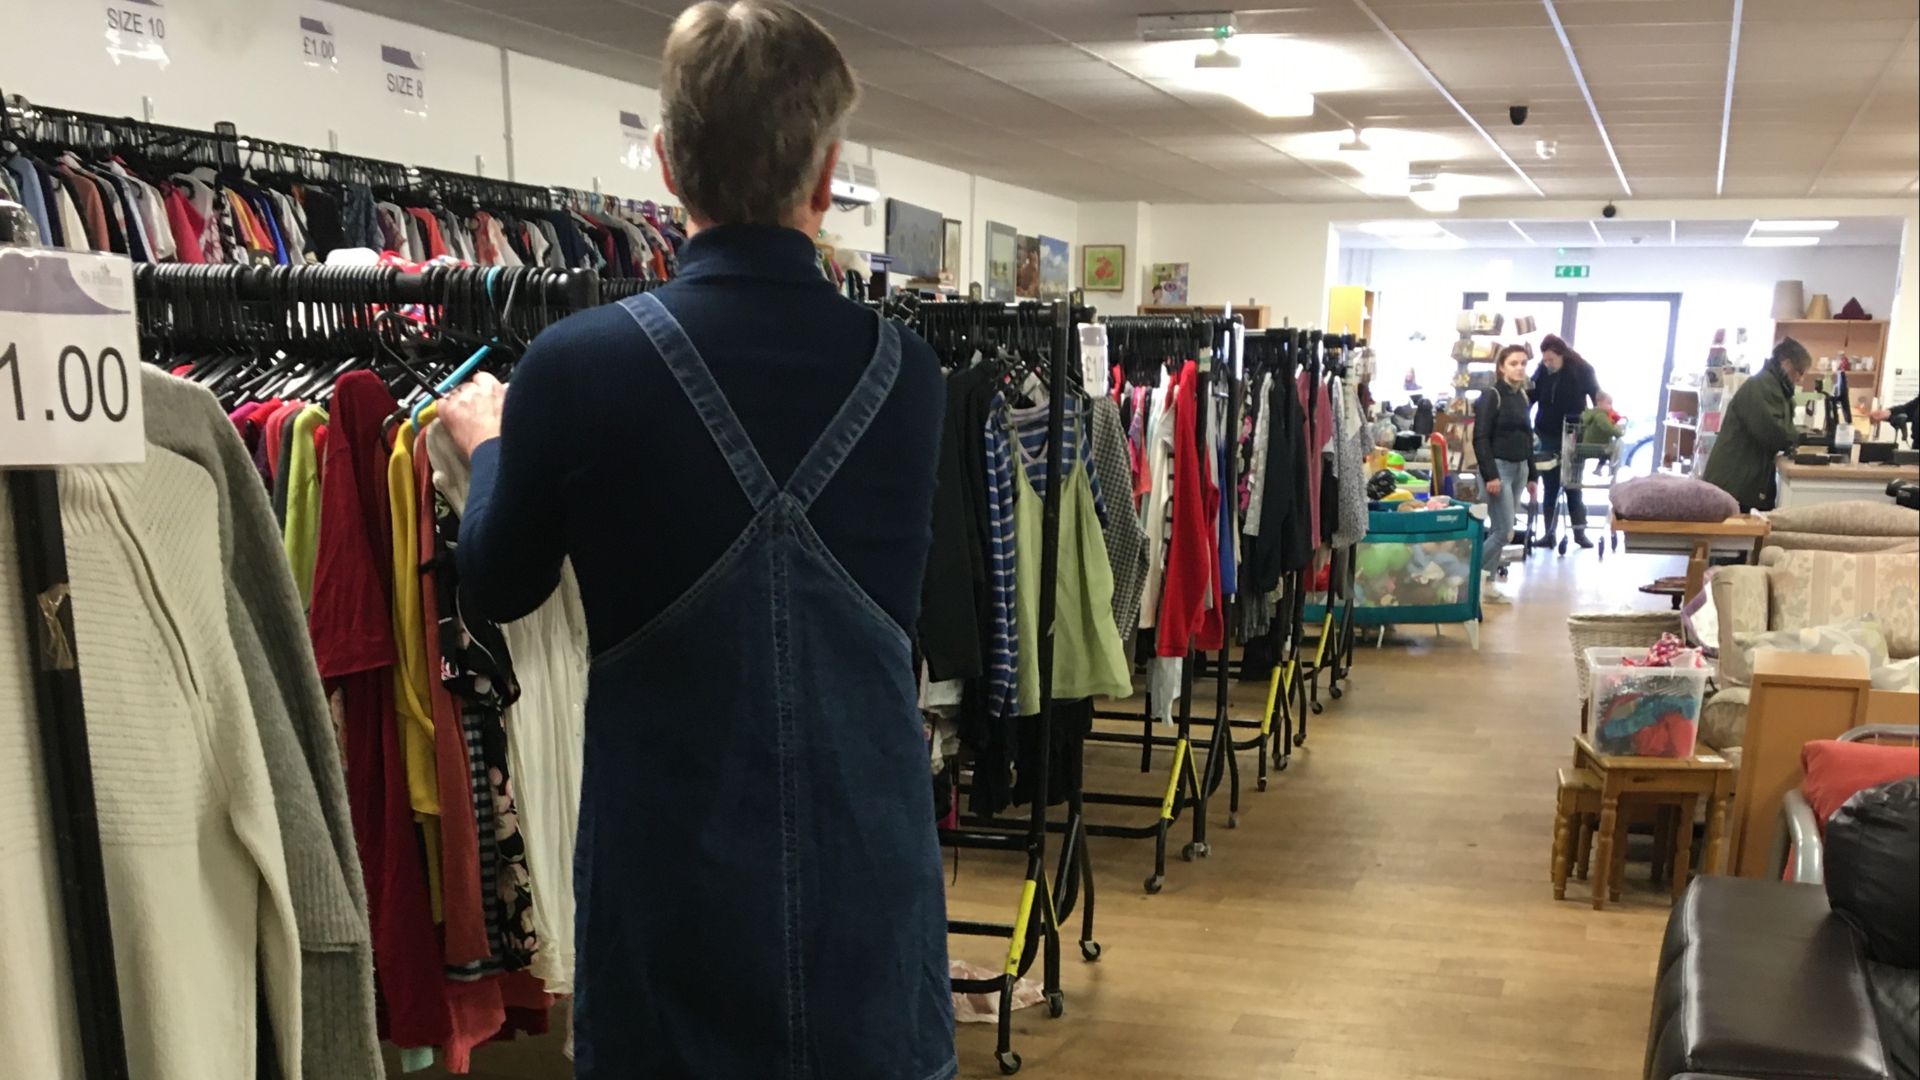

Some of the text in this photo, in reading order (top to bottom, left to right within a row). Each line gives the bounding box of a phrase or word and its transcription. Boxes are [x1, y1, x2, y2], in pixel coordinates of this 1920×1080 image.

[106, 7, 165, 39] SIZE 10
[302, 36, 335, 59] £1.00
[386, 72, 424, 99] SIZE 8
[0, 342, 129, 422] 1.00
